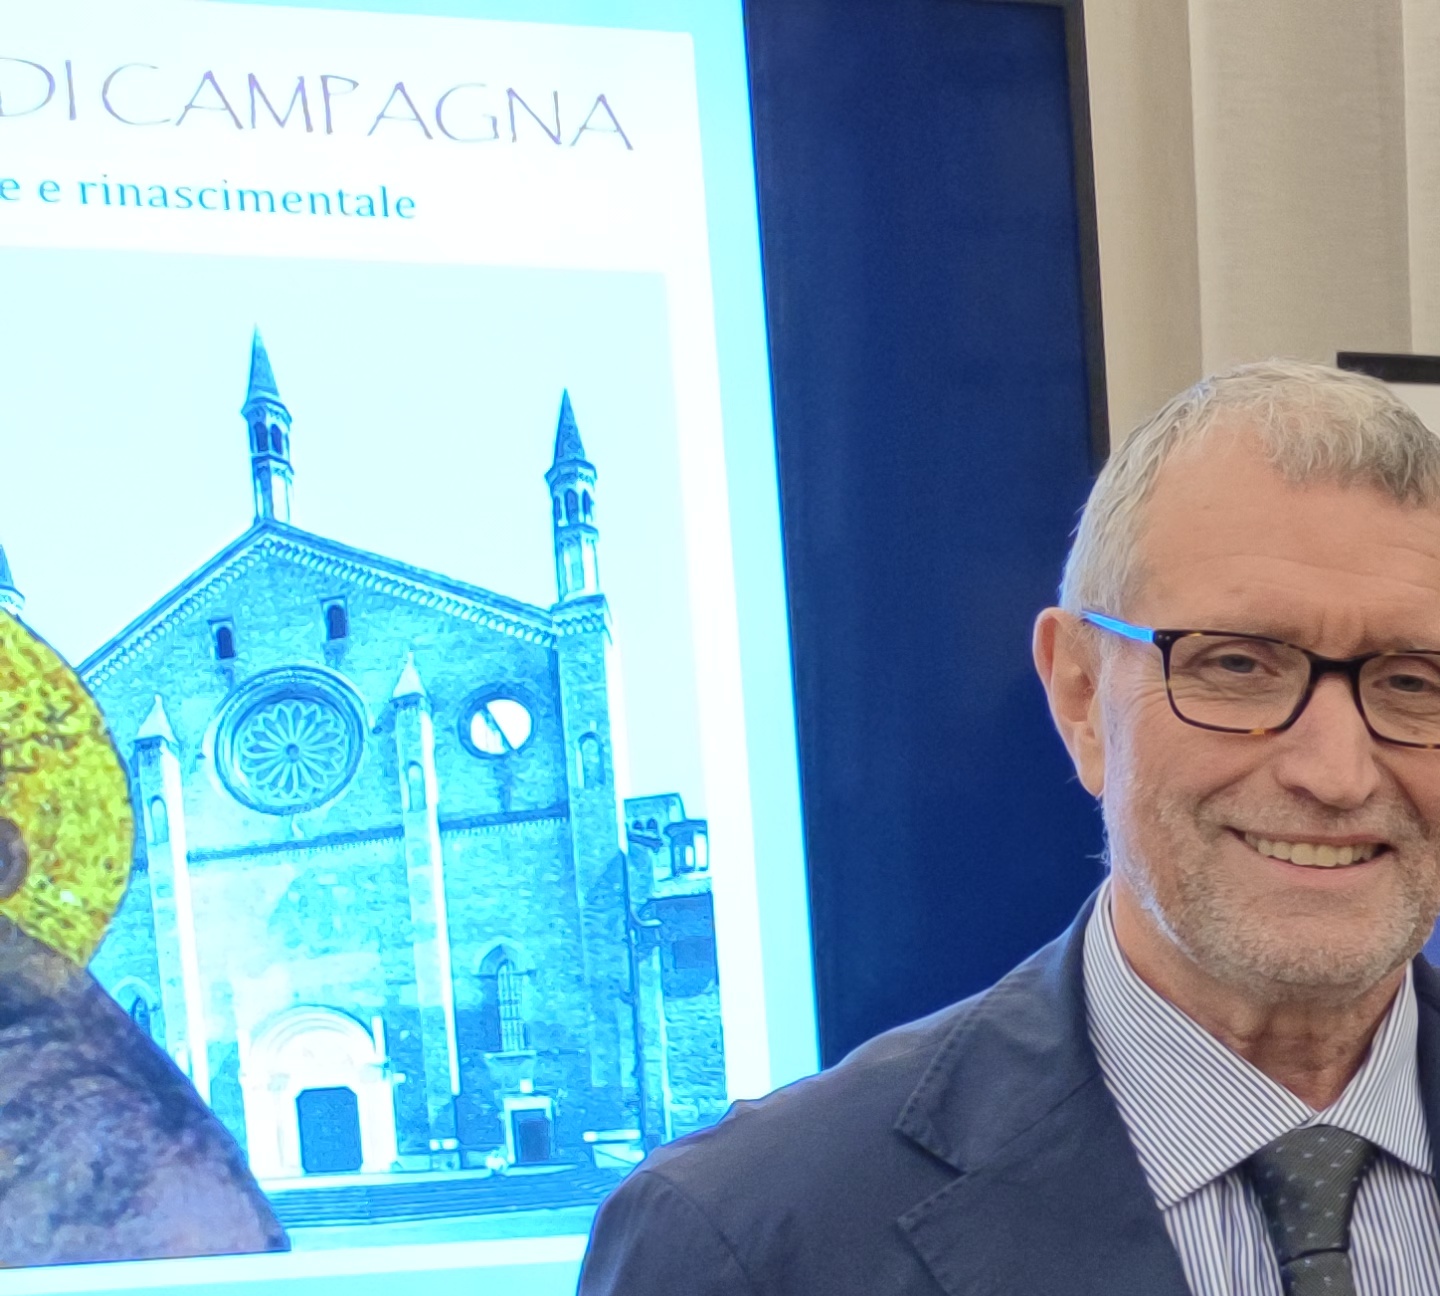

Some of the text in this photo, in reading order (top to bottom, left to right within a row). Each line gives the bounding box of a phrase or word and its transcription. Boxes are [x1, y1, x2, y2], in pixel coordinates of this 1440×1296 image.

[0, 57, 634, 151] DI CAMPAGNA
[38, 178, 61, 204] e
[77, 172, 417, 220] rinascimentale
